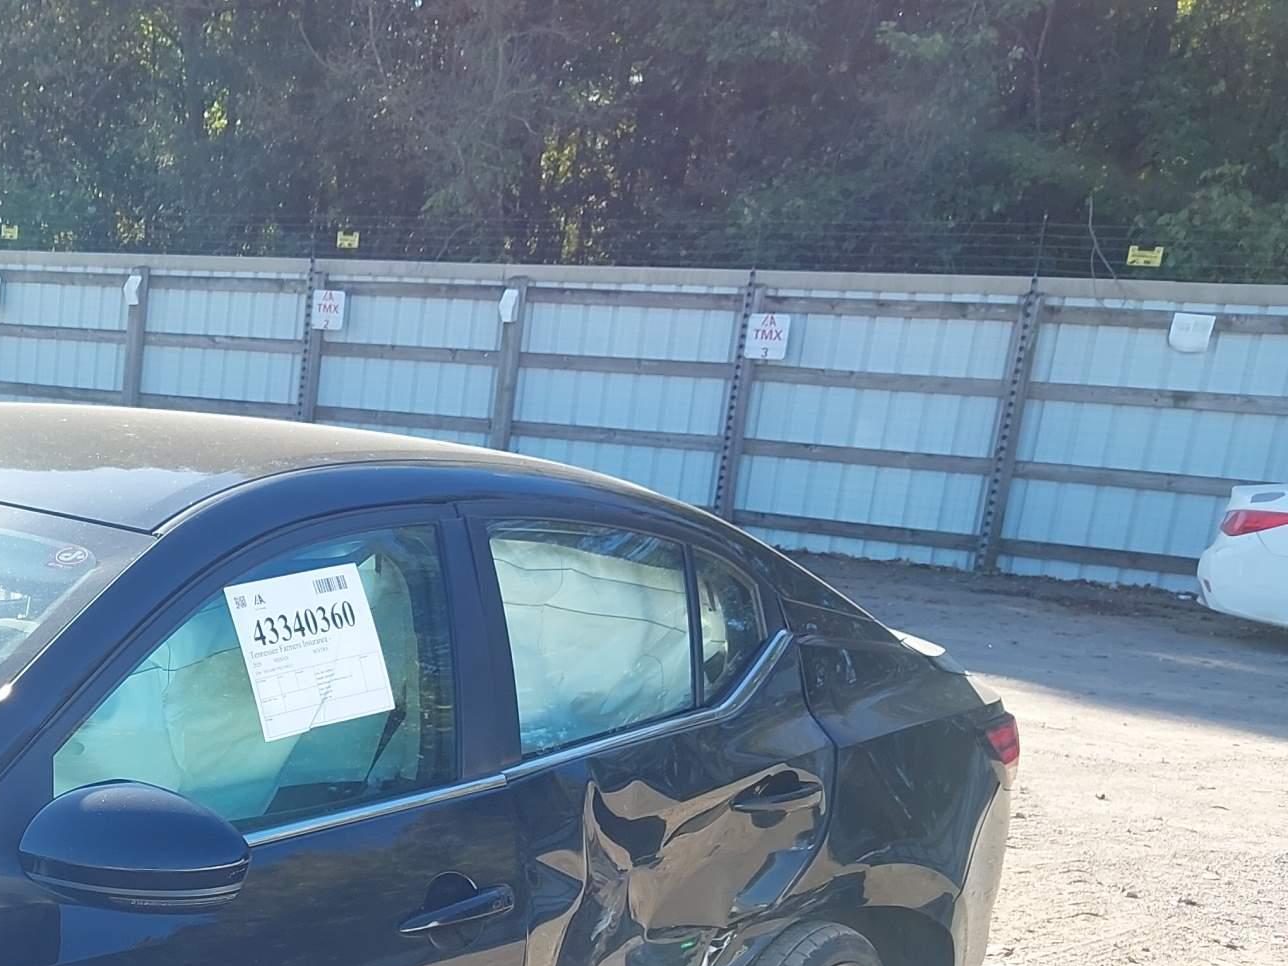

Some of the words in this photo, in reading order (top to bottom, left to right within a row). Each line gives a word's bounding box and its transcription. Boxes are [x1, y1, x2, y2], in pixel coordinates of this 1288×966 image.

[317, 303, 339, 314] TMX
[323, 320, 329, 329] 2
[754, 328, 783, 341] TMX
[761, 347, 769, 358] 3
[253, 600, 356, 646] 43340360
